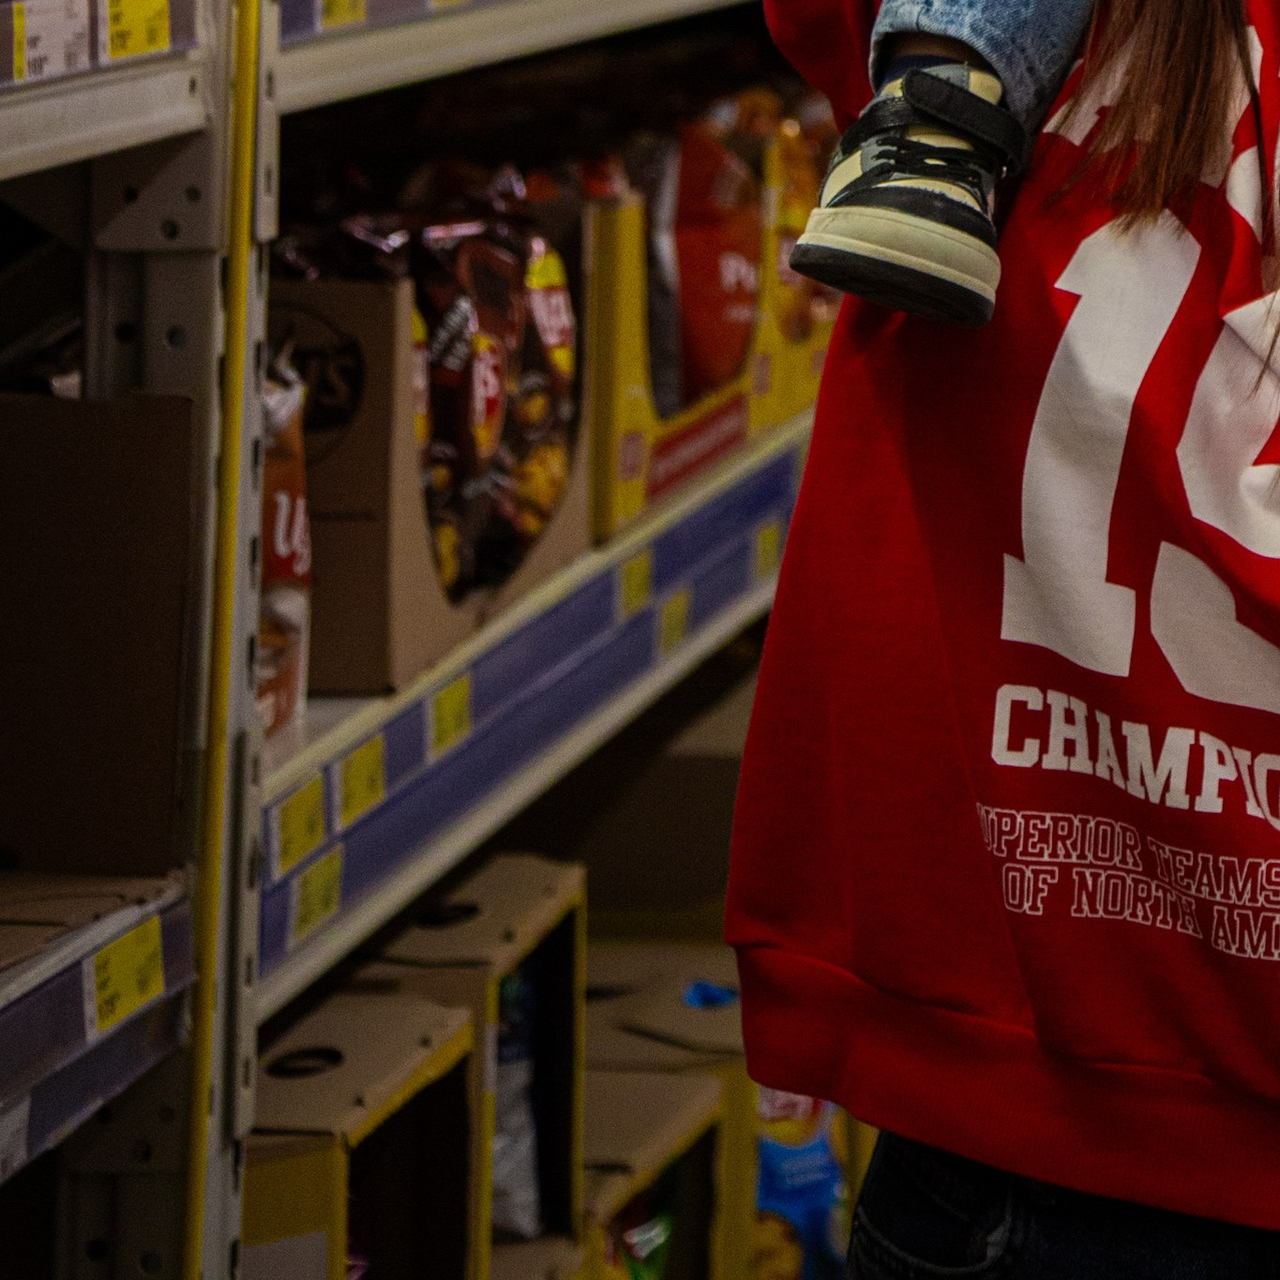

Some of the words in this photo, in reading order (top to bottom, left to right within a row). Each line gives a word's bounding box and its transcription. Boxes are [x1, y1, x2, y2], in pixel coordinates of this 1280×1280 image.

[976, 802, 1143, 871] UPERIOR
[1002, 862, 1059, 914] OF
[1071, 867, 1203, 939] NORTH
